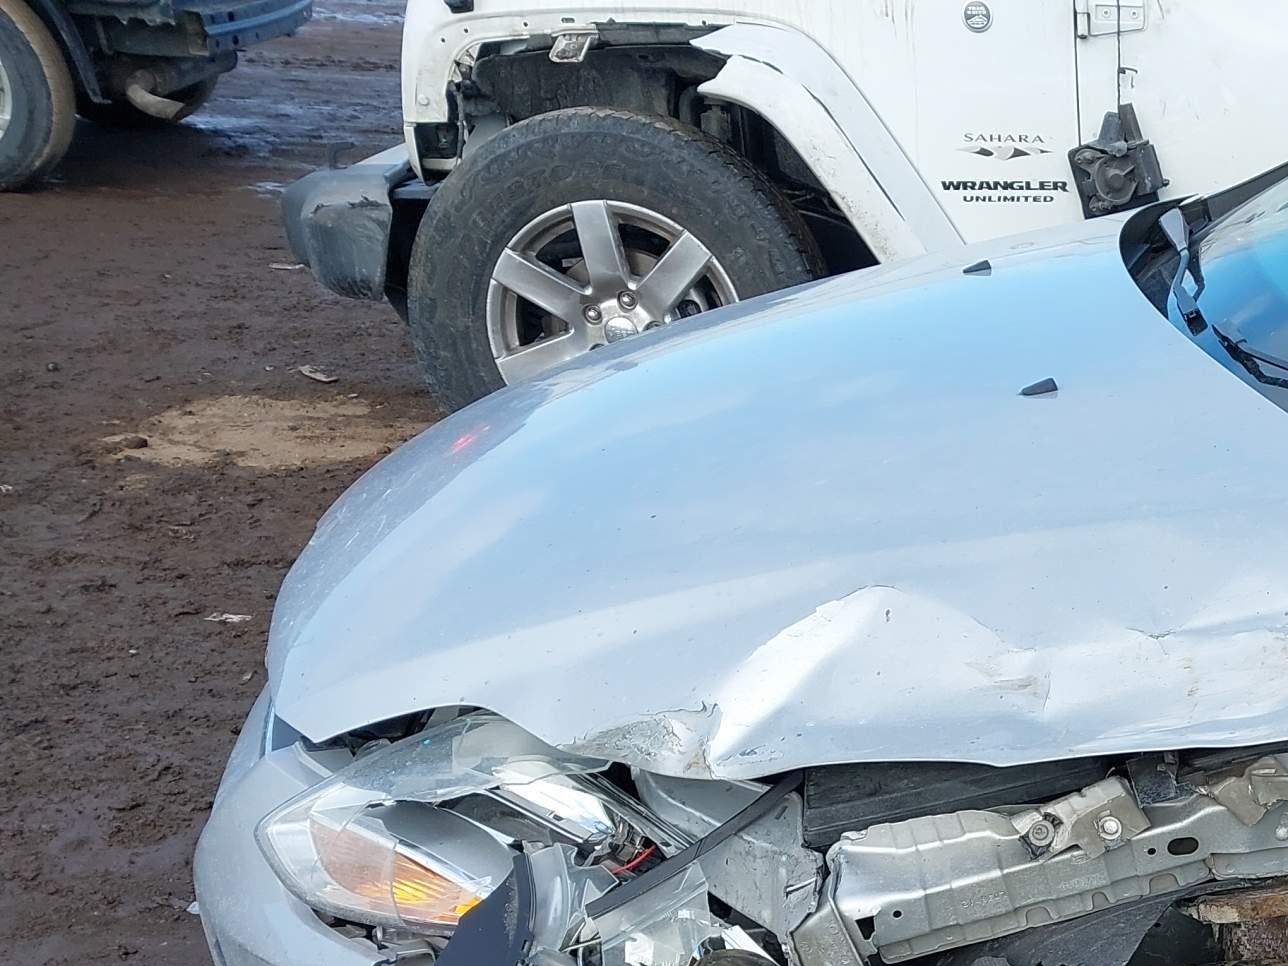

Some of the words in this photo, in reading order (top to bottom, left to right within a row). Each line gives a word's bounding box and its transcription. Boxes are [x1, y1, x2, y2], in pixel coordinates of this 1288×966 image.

[963, 133, 1045, 144] SAHARA
[941, 180, 1069, 193] WRANGLER
[962, 195, 1055, 203] UNLIMITED
